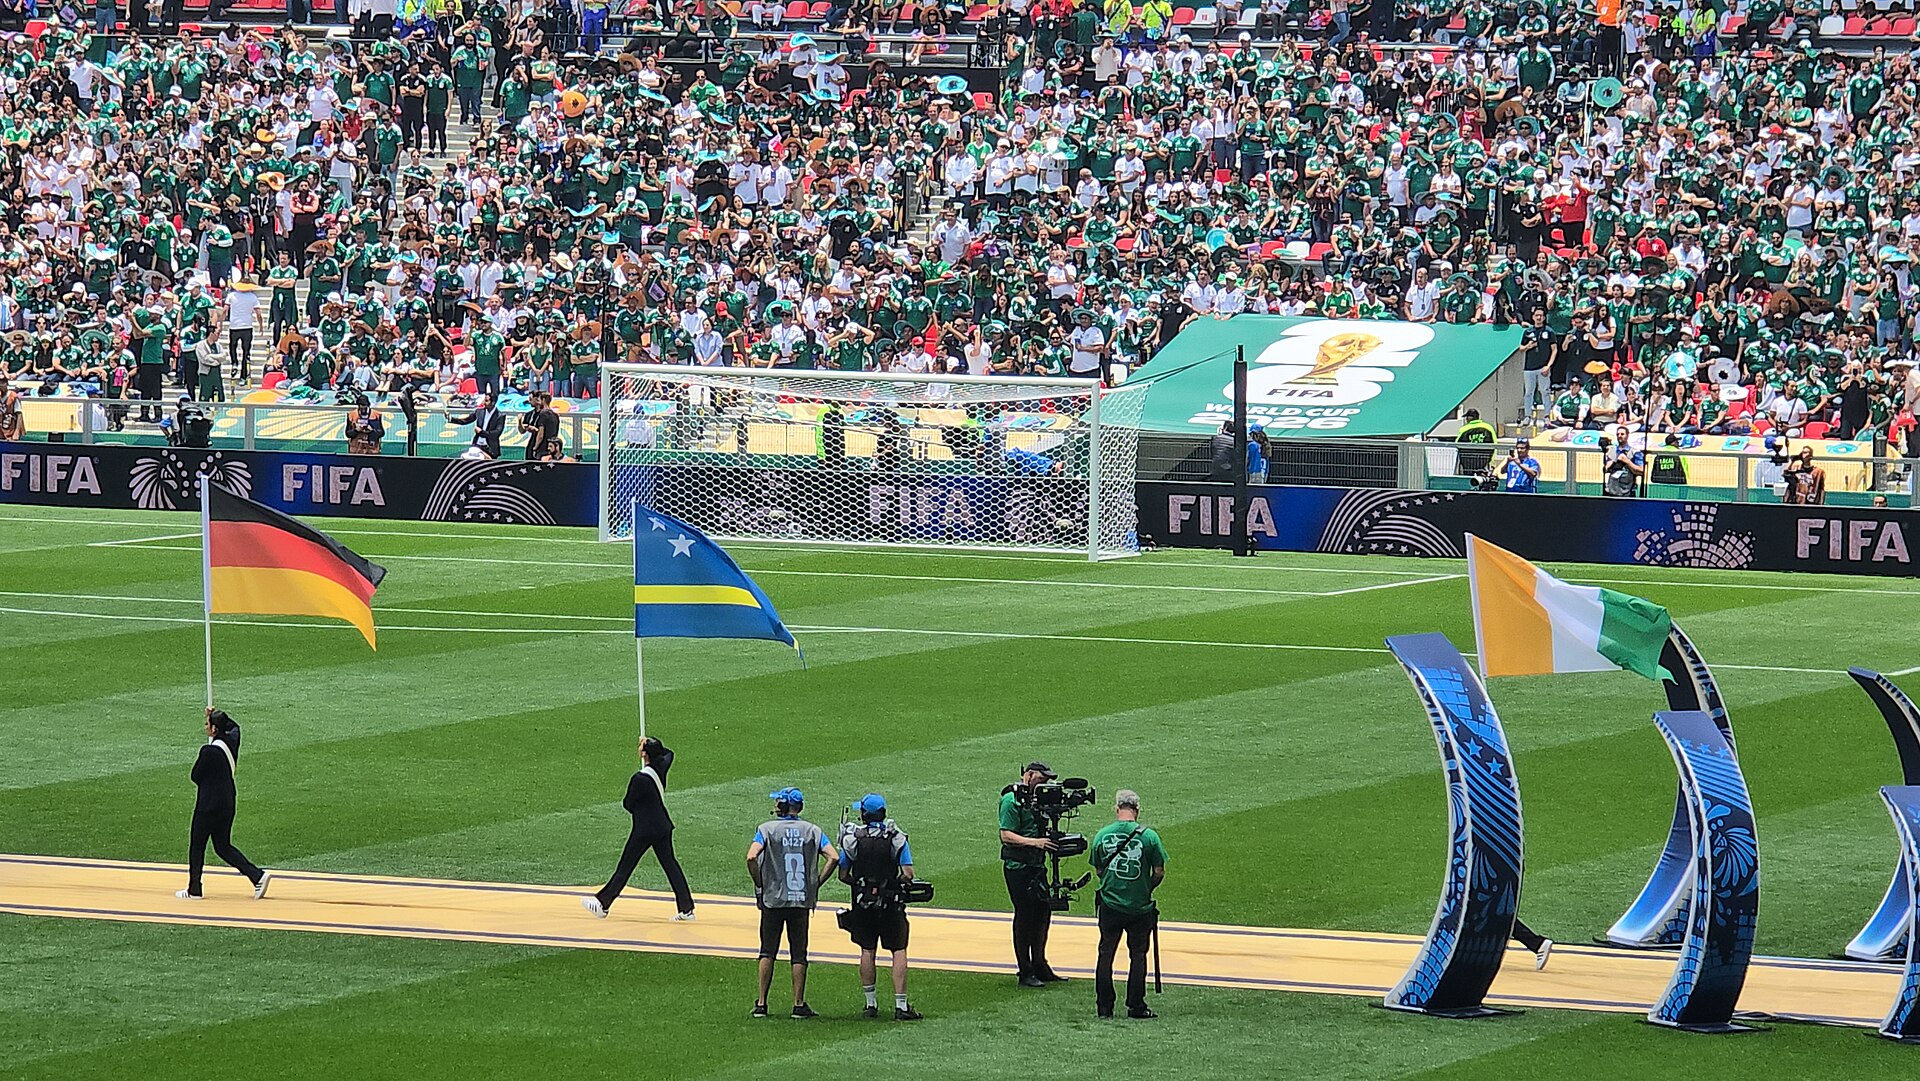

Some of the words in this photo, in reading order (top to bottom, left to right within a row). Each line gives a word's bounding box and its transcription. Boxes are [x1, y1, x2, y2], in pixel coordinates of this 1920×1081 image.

[1266, 388, 1334, 399] FIFA
[1305, 408, 1361, 417] CUP
[1, 453, 101, 494] FIFA
[283, 464, 385, 506] FIFA
[869, 485, 976, 526] FIFA
[1169, 495, 1278, 537] FIFA
[1797, 519, 1910, 563] FIFA
